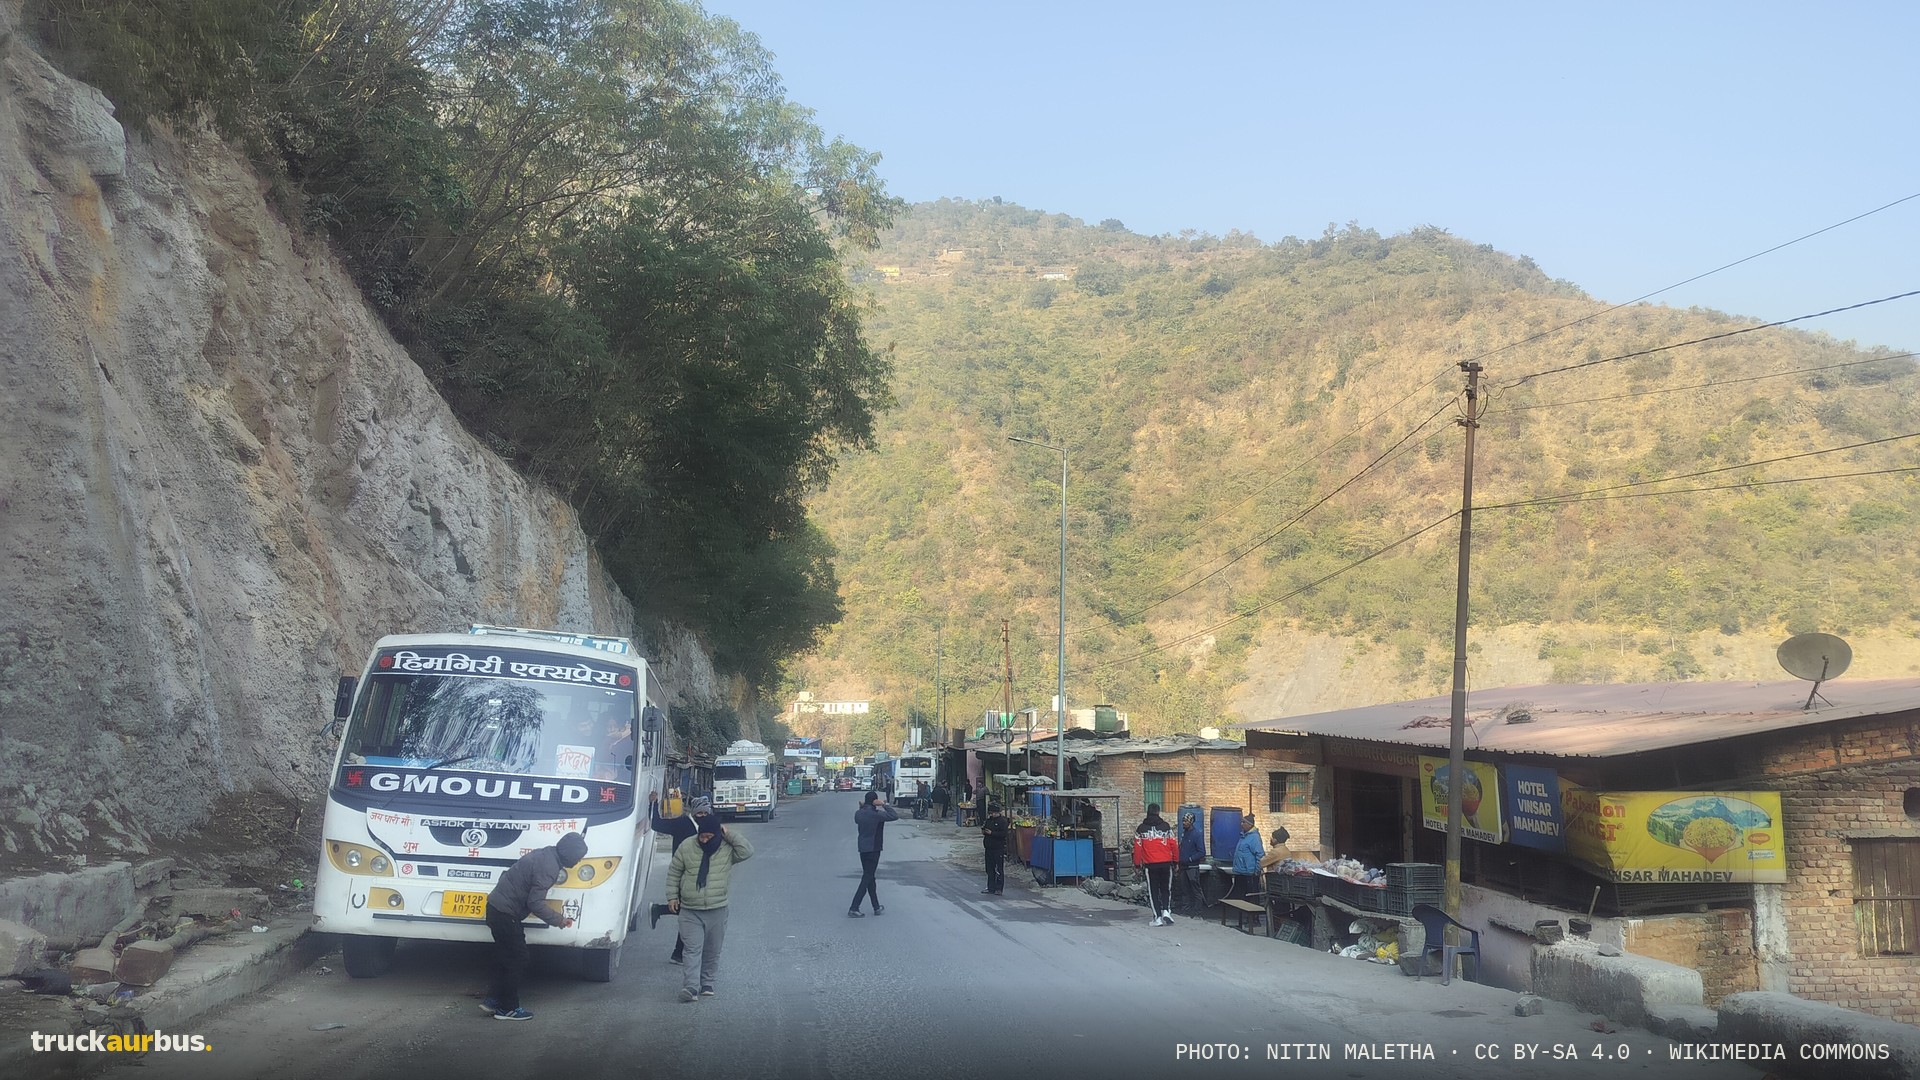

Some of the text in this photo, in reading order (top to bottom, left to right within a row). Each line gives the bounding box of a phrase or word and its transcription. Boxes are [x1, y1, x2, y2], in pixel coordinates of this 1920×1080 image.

[392, 651, 619, 685] हिमगिरी एक्सप्रेस
[370, 772, 589, 803] GMOULTD
[1517, 780, 1548, 797] HOTEL
[1517, 798, 1552, 817] VINSAR
[421, 820, 530, 830] ASHOK LEYLAND
[1425, 819, 1443, 830] HOTEL
[1466, 828, 1496, 843] MAHADEV
[1513, 815, 1559, 837] MAHADEV
[455, 870, 490, 878] CHEETAH
[1658, 869, 1733, 882] MAHADEV
[454, 894, 483, 905] UK12P
